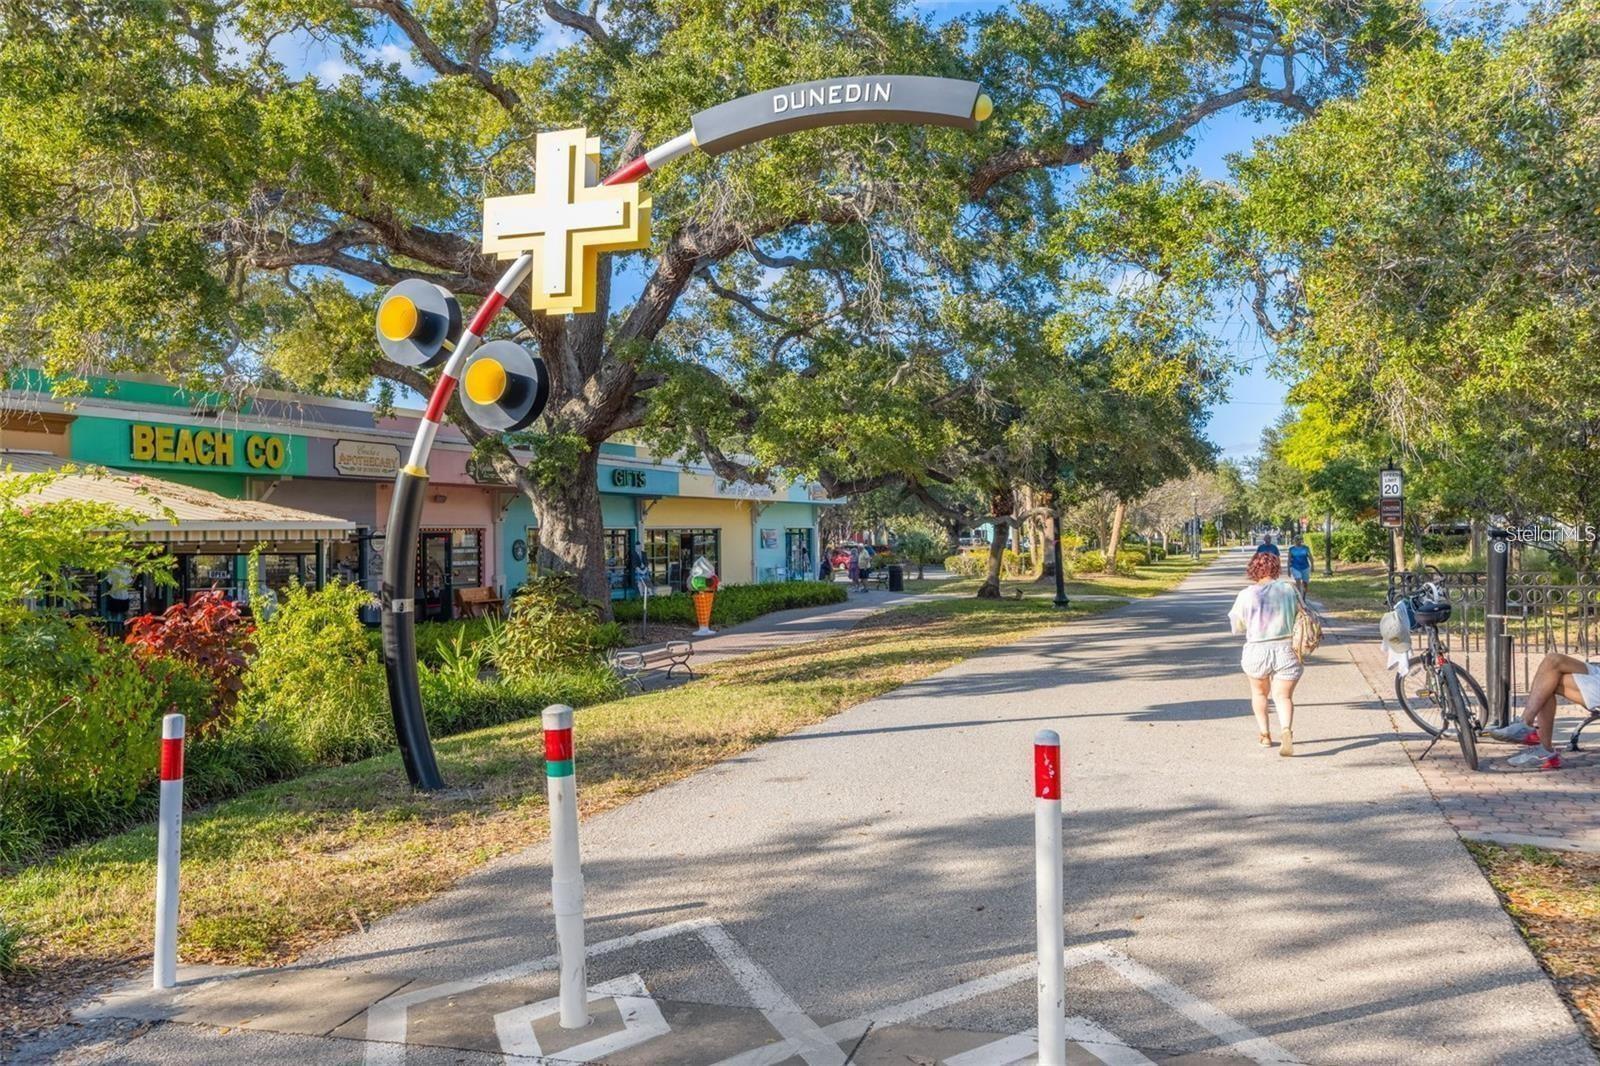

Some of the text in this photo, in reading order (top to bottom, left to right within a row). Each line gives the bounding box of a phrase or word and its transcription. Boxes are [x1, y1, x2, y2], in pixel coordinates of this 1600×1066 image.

[773, 82, 891, 113] DUNEDIN
[131, 424, 285, 469] BEACH CO
[338, 452, 398, 468] APOTHECARY
[612, 469, 647, 488] GIFTS
[1384, 484, 1399, 494] 20
